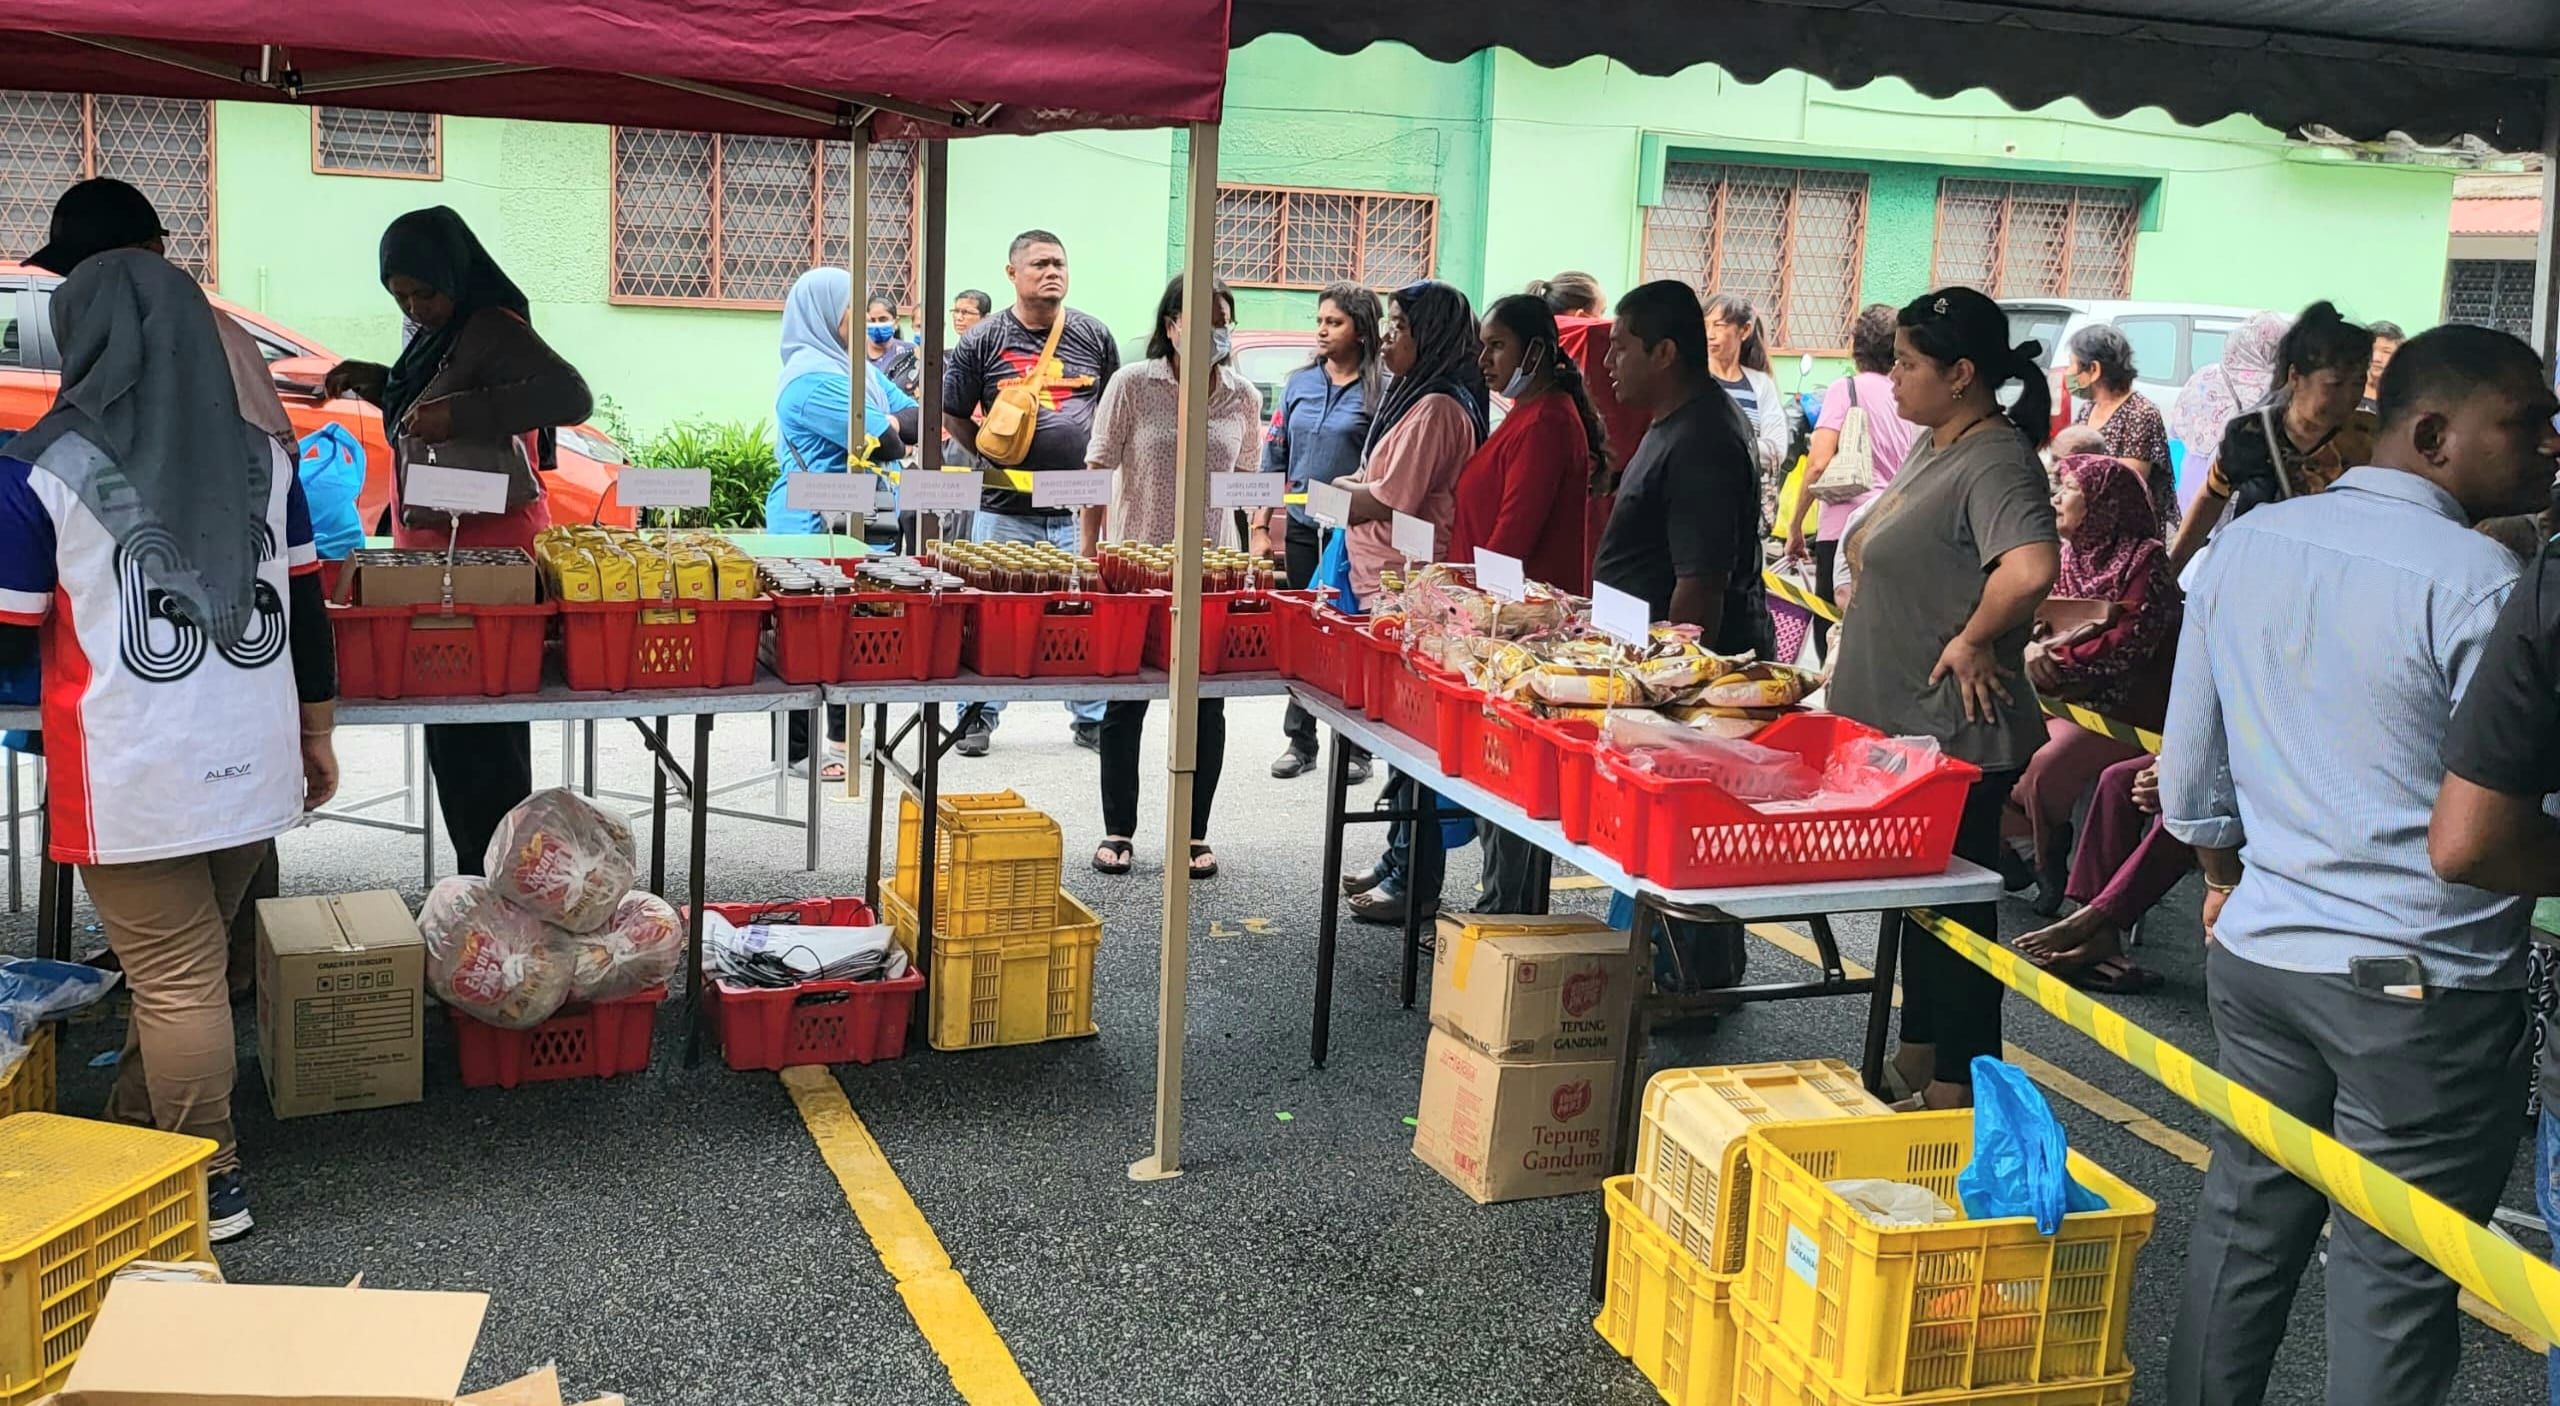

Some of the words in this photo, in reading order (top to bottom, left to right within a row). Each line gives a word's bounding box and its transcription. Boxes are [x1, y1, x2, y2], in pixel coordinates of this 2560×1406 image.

[1560, 1019, 1607, 1034] TEPUNG
[1553, 1036, 1608, 1051] GANDUM
[1532, 1125, 1601, 1151] Tepung
[1522, 1146, 1603, 1172] Gandum
